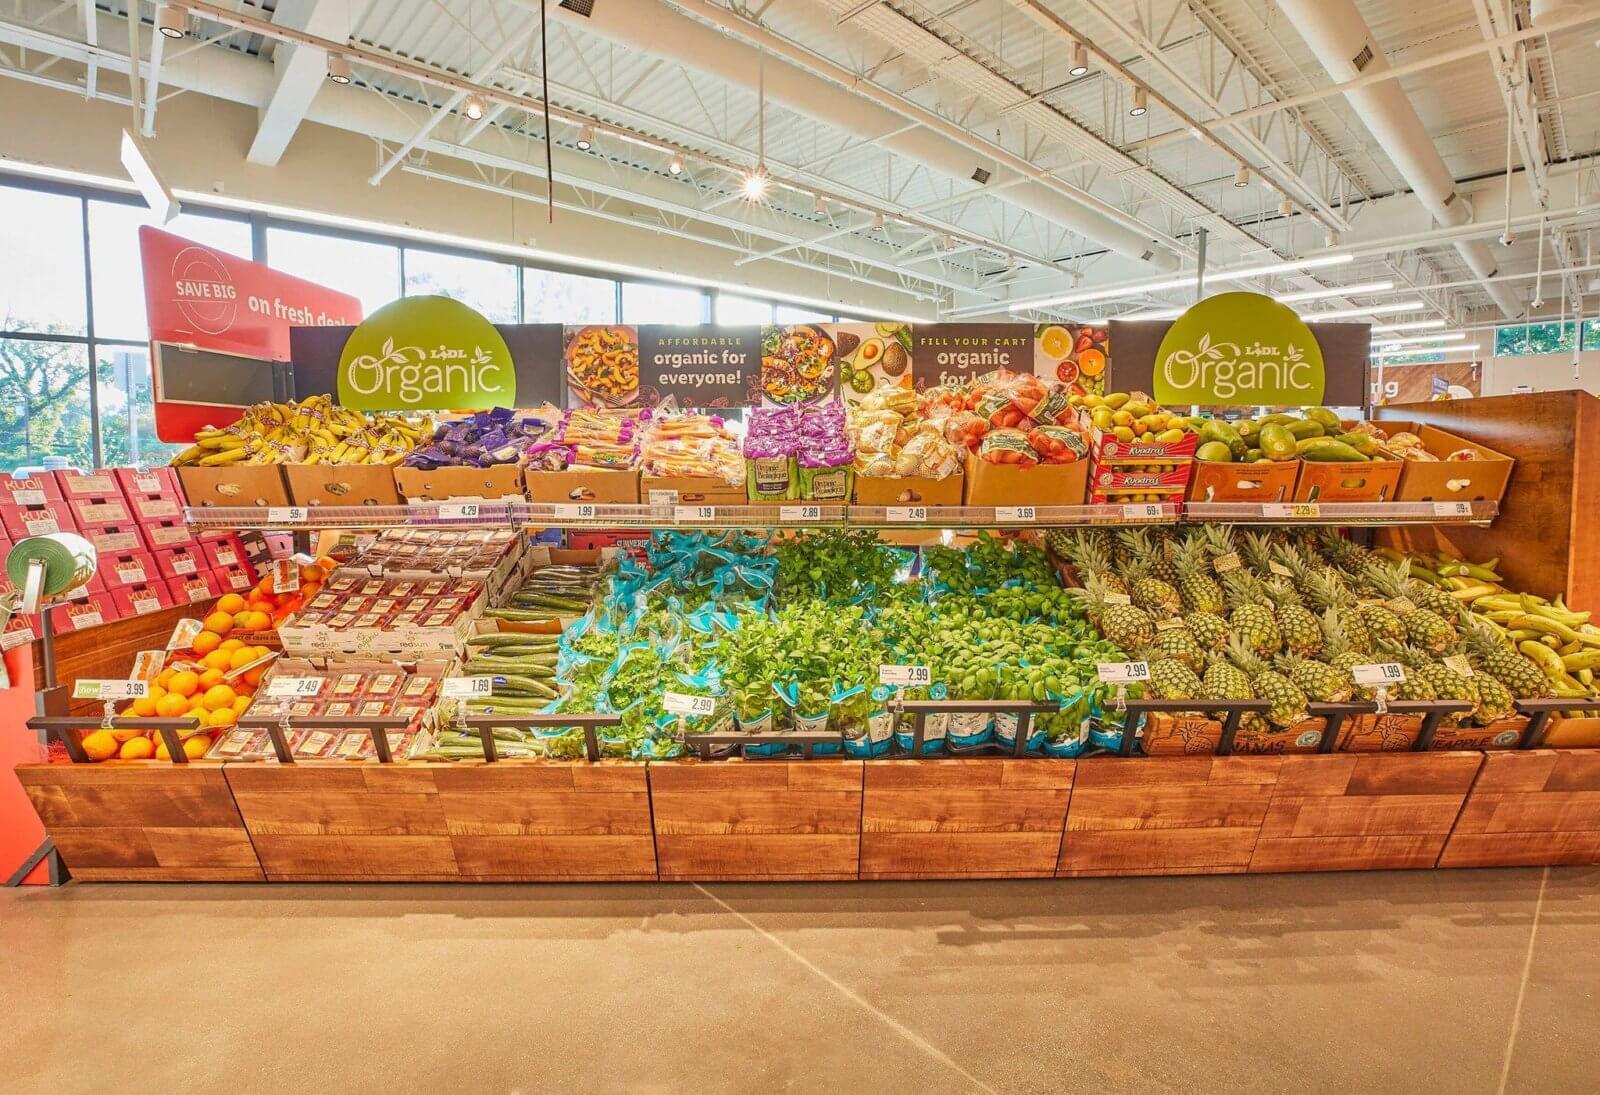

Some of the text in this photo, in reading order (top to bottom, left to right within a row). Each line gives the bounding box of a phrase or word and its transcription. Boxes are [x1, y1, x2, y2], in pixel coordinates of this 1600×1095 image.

[176, 280, 236, 299] SAVE BIG
[248, 296, 271, 316] on
[273, 298, 314, 326] fresh
[658, 338, 742, 346] AFFORDABLE
[920, 338, 1027, 346] FILL YOUR CART
[654, 349, 747, 368] organic for
[937, 348, 1010, 369] organic
[348, 348, 501, 403] Organic
[658, 370, 742, 388] everyone!
[939, 370, 967, 387] for
[1163, 346, 1312, 399] Organic
[461, 505, 477, 516] 4.29
[578, 506, 593, 516] 1.99
[698, 507, 712, 518] 1.19
[802, 507, 818, 518] 2.89
[908, 508, 925, 519] 2.49
[1017, 508, 1034, 519] 3.69
[908, 667, 928, 681] 2.99
[1125, 663, 1147, 677] 2.99
[1380, 664, 1401, 678] 1.99
[126, 683, 144, 695] 3.99
[297, 680, 319, 692] 2.49
[471, 679, 489, 692] 1.69
[692, 697, 712, 711] 2.99
